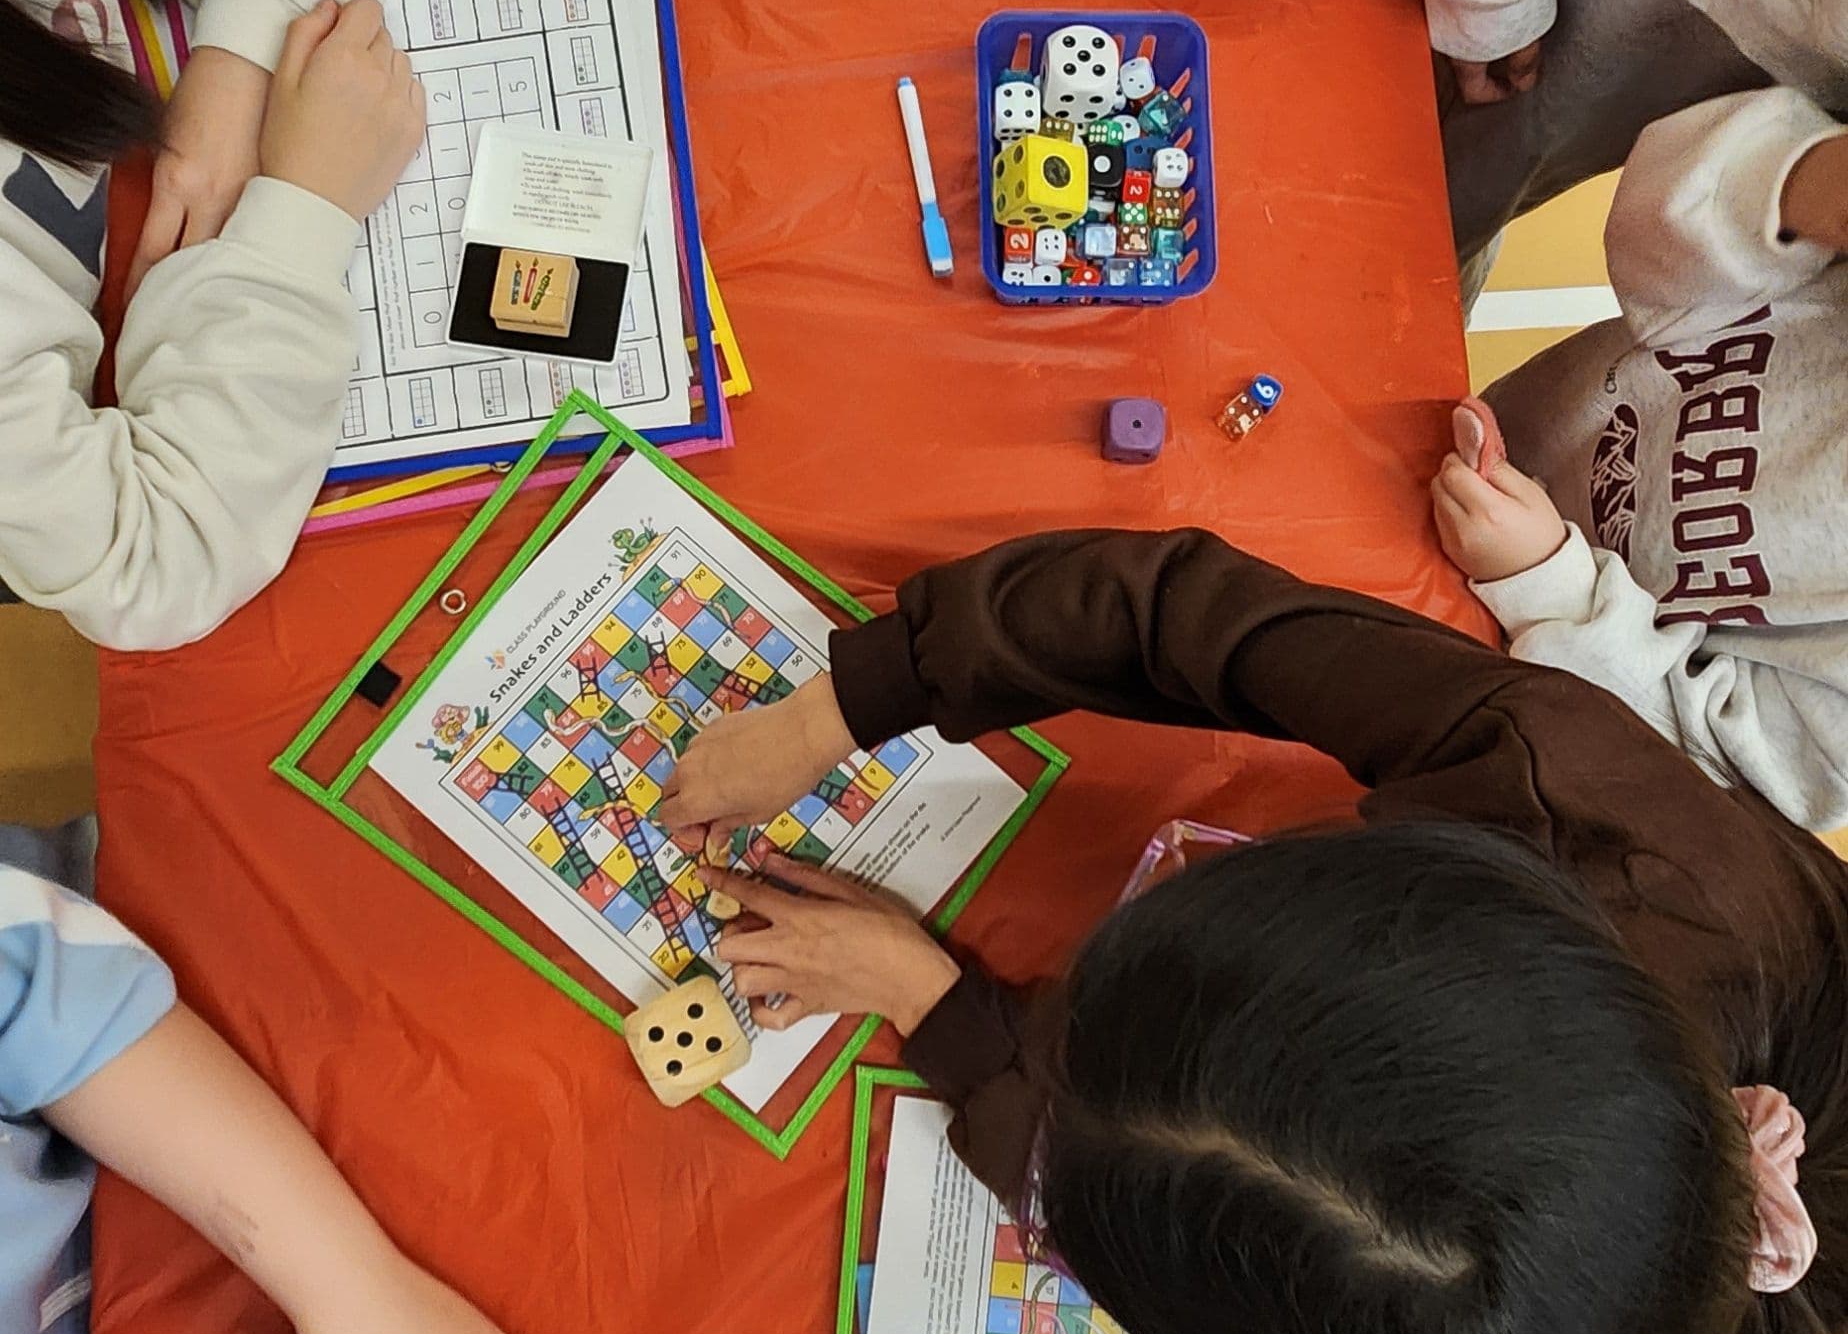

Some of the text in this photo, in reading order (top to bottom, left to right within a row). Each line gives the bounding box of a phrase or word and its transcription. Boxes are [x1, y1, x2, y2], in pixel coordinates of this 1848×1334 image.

[510, 81, 527, 92] 5
[434, 91, 451, 102] 2
[448, 197, 466, 210] 0
[410, 205, 428, 215] 2
[424, 312, 441, 323] 0
[505, 586, 567, 655] CLASS PLAYGROUND
[487, 649, 538, 705] Snakes
[532, 623, 563, 656] and
[558, 568, 612, 629] Ladders
